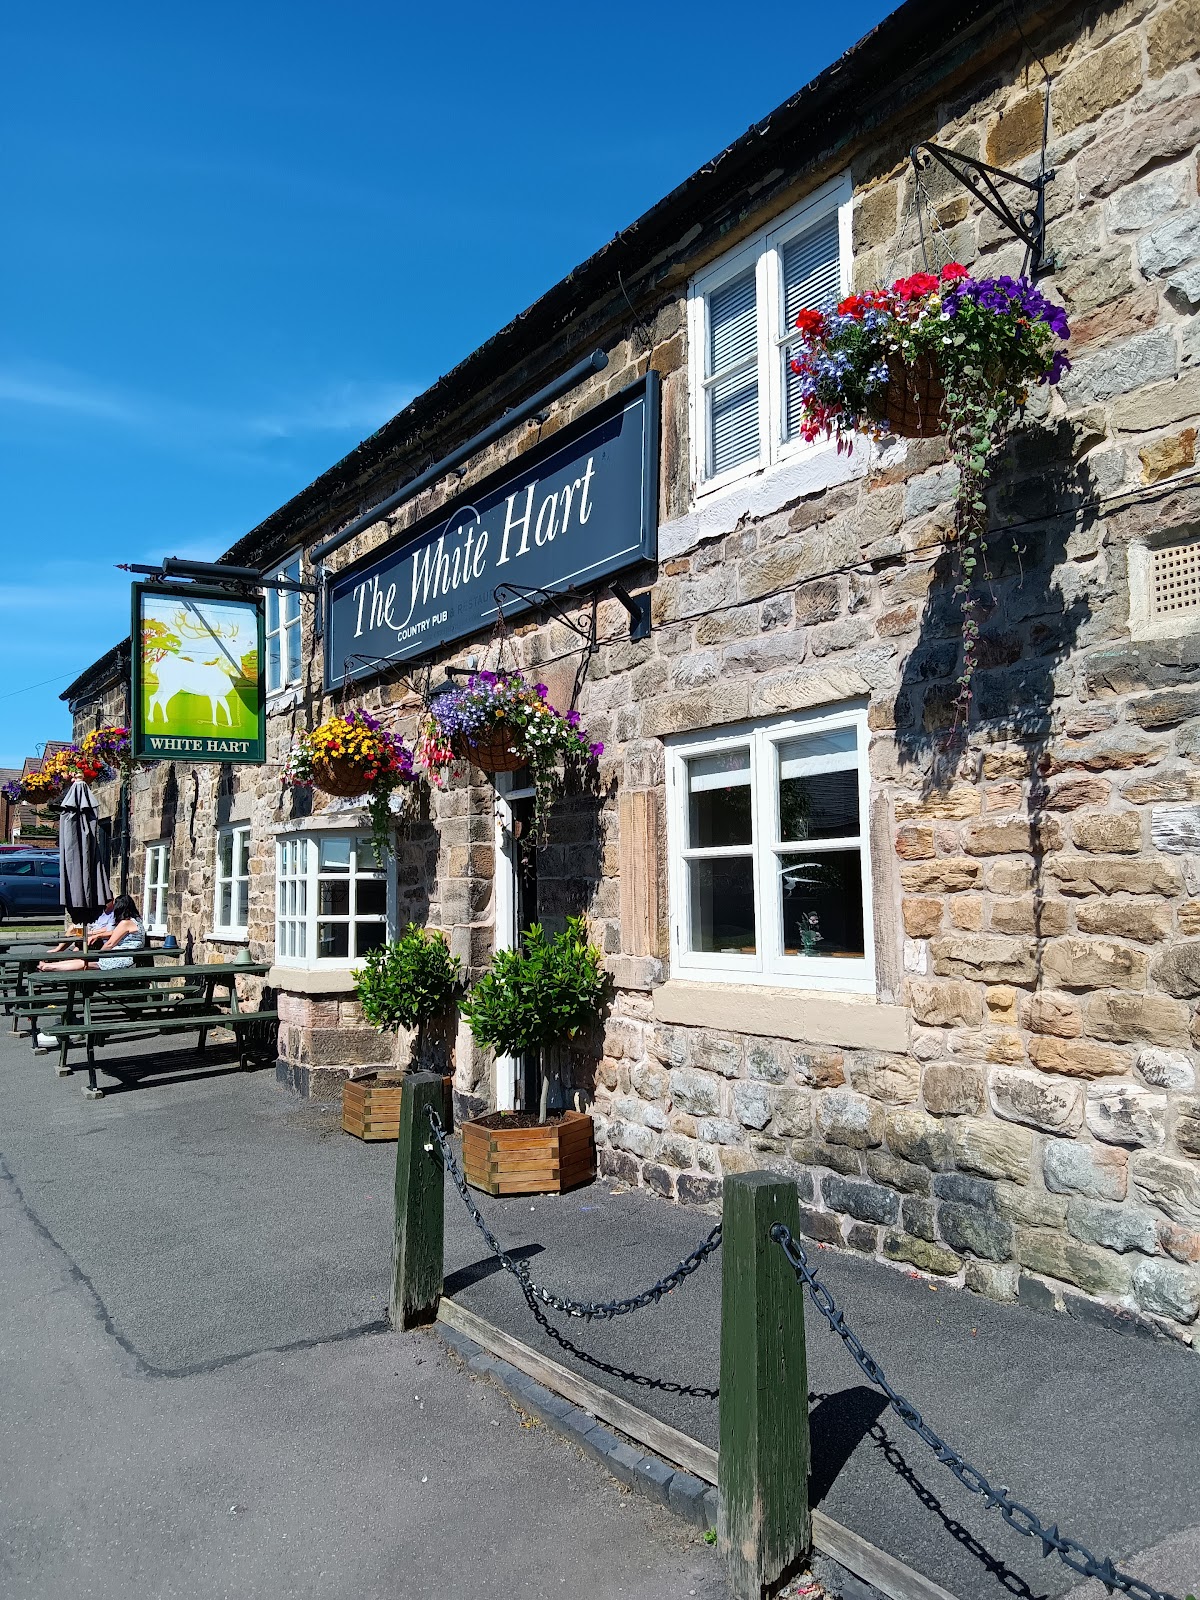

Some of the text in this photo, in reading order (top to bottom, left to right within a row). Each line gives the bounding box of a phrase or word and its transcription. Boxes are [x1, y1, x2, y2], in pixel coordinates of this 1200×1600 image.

[353, 457, 595, 638] The White Hart
[397, 618, 430, 642] COUNTRY
[432, 611, 448, 627] PUB
[150, 737, 250, 753] WHITE HART
